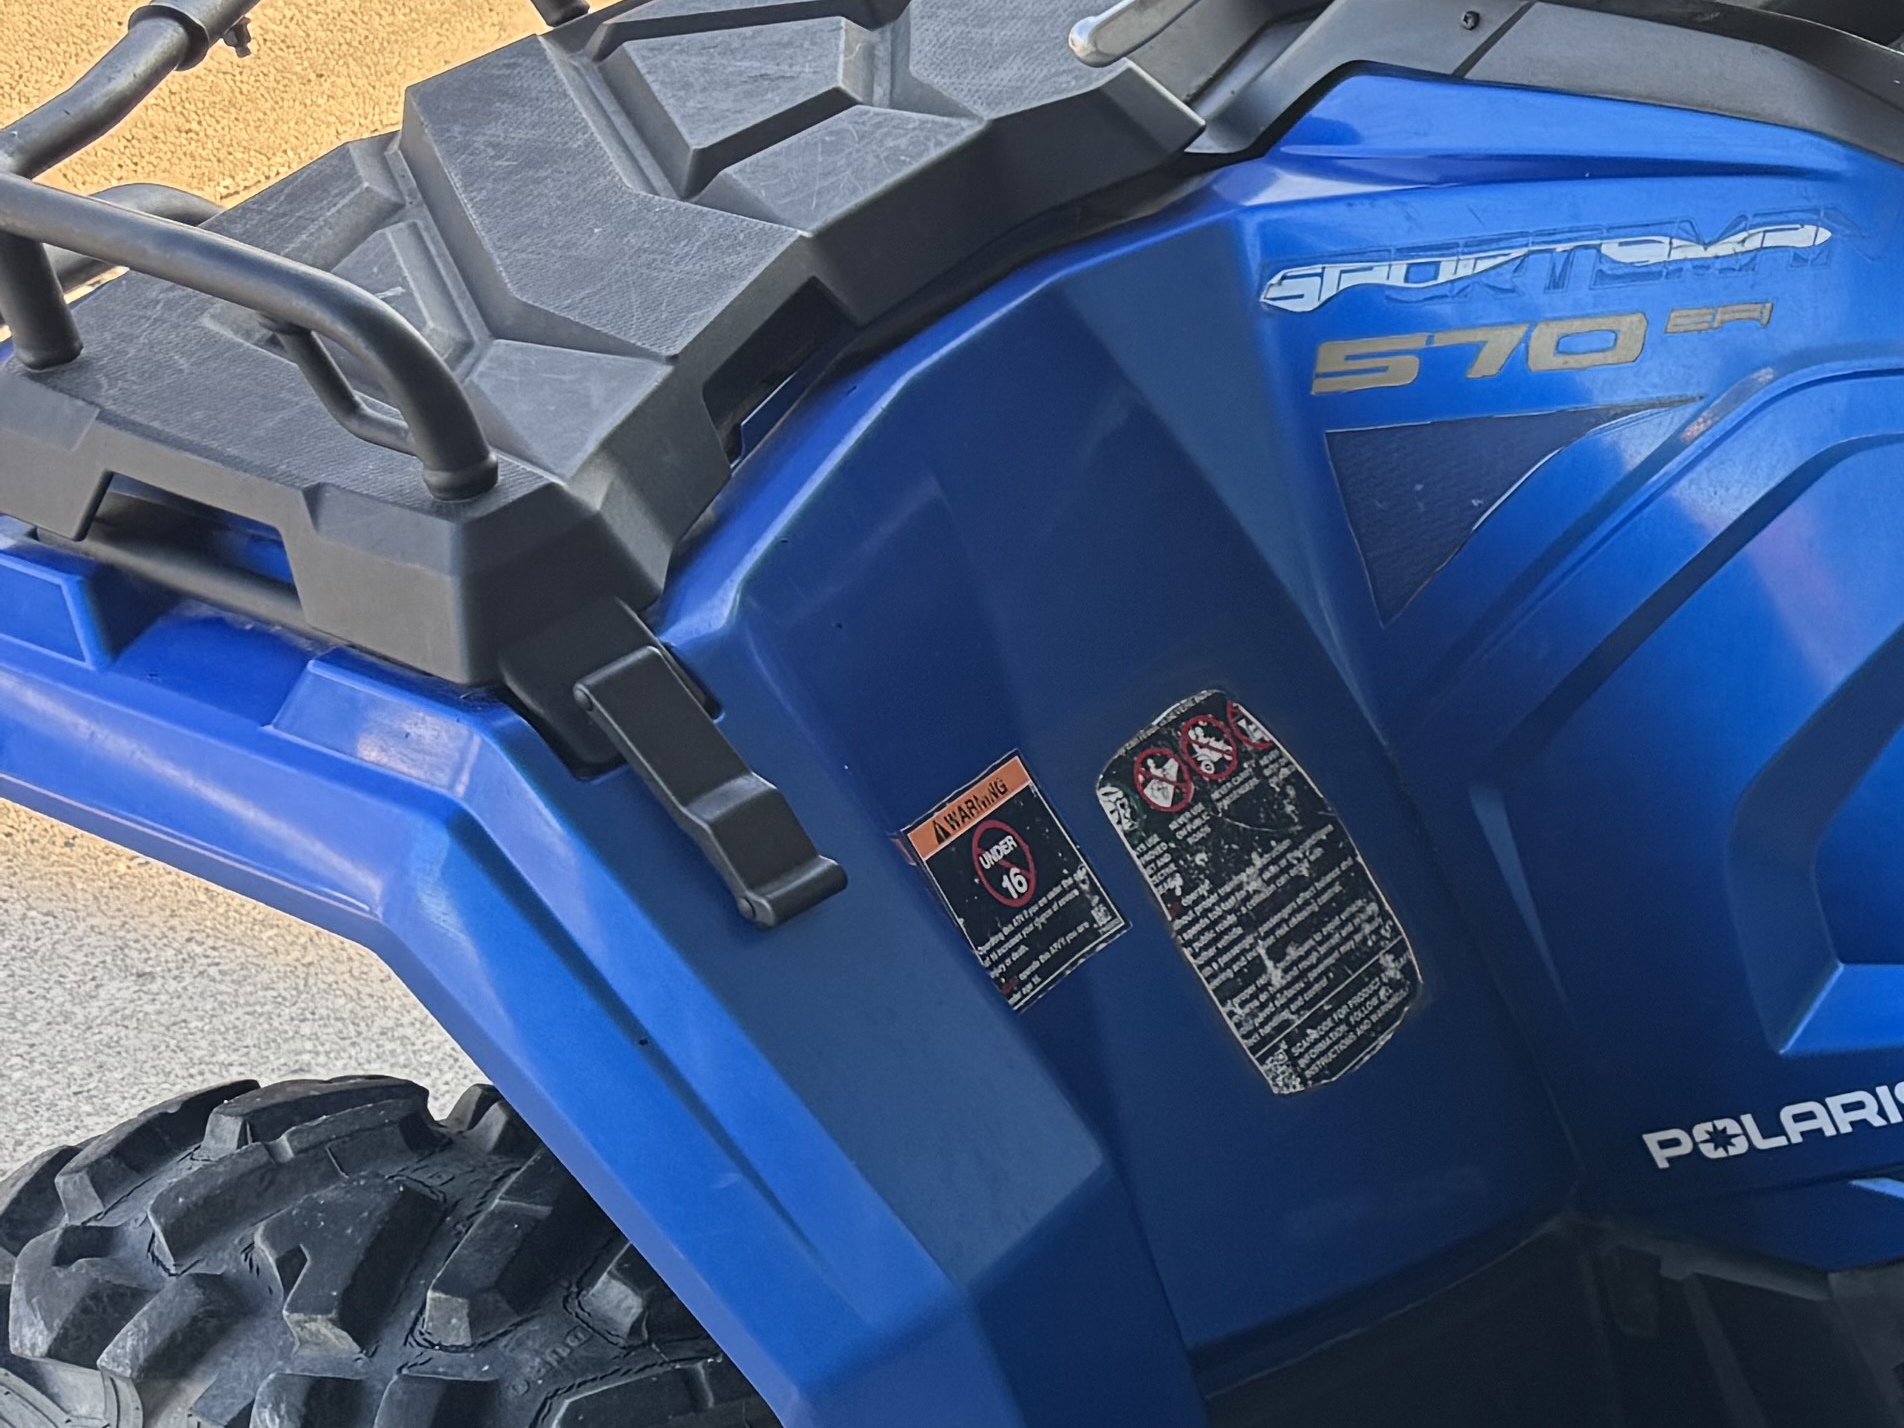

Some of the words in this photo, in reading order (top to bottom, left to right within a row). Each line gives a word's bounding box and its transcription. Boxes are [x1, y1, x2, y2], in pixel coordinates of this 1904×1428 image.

[1311, 311, 1649, 396] 570
[1665, 301, 1774, 335] EFI
[980, 835, 1017, 870] UNDER
[1002, 867, 1030, 900] 16
